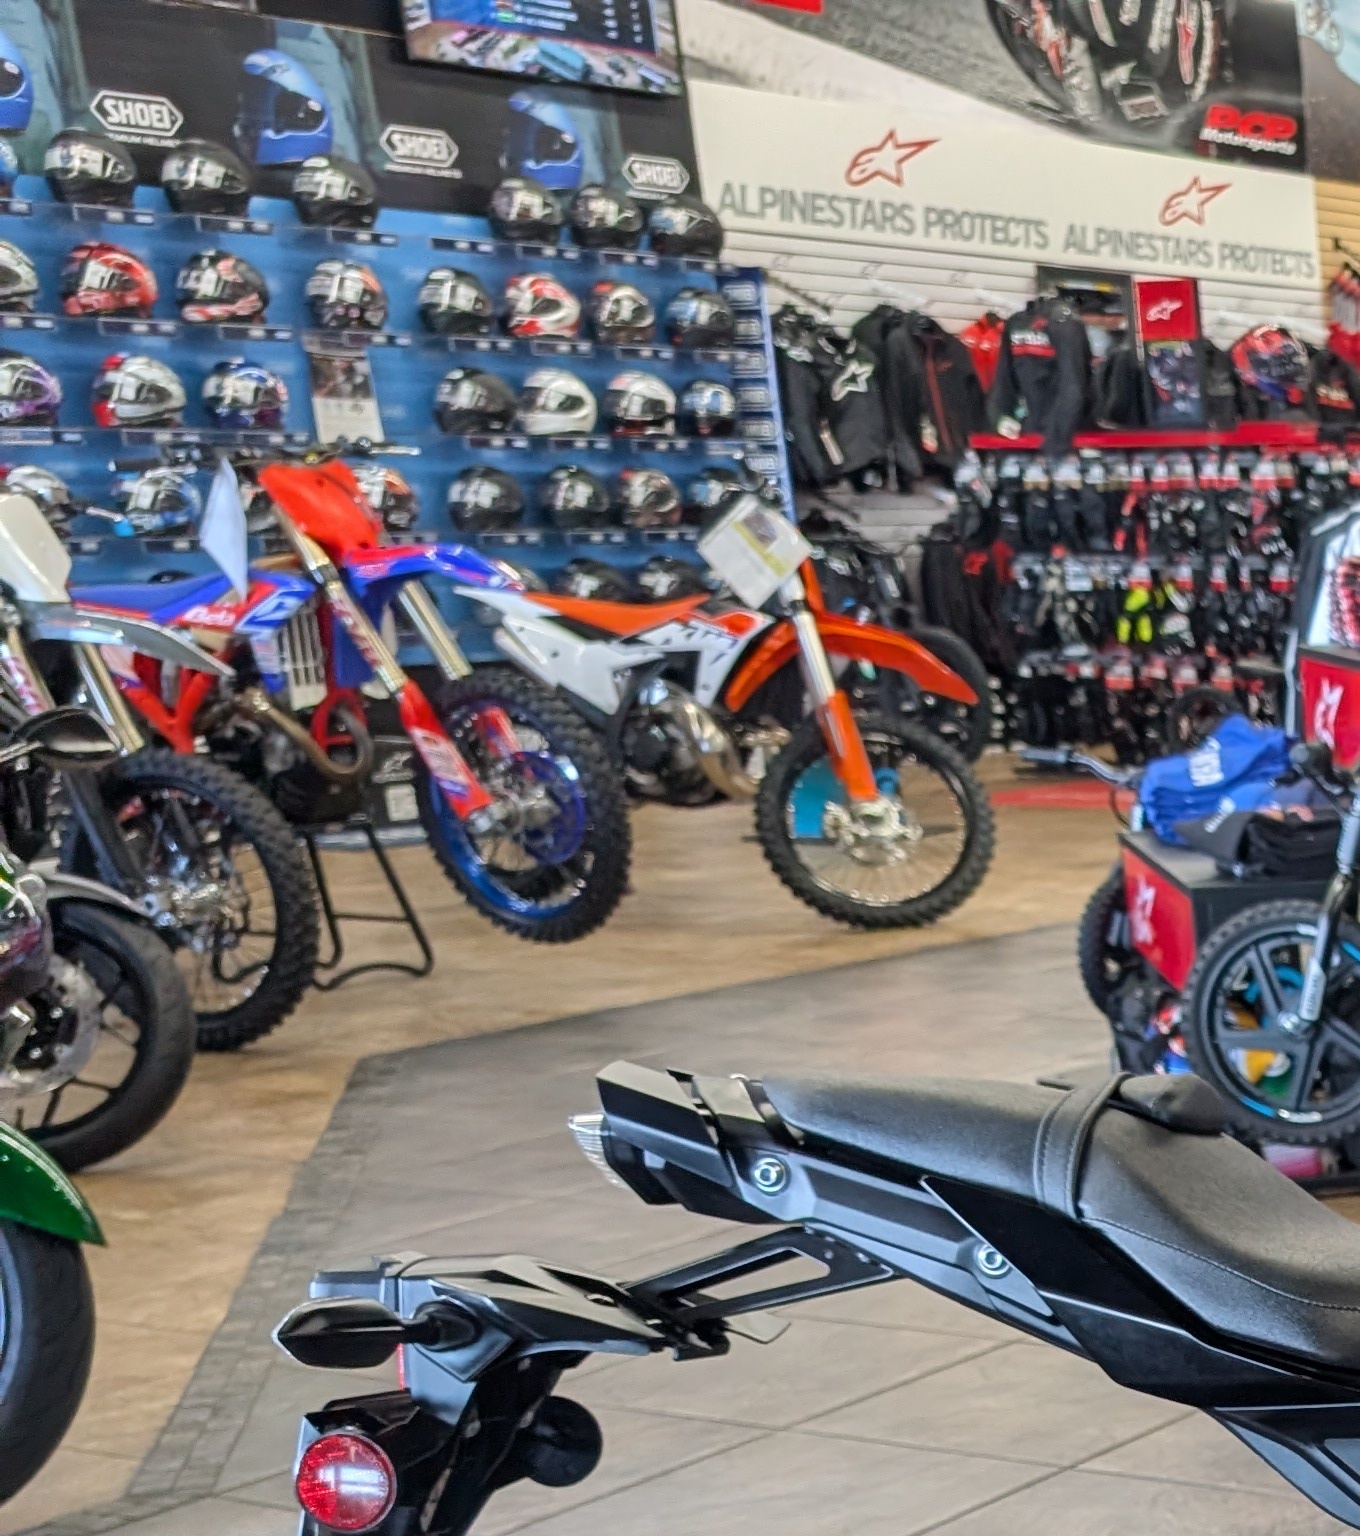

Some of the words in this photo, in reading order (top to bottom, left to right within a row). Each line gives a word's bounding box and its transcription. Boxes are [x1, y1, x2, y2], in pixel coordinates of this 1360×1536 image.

[102, 98, 172, 130] SHOEI
[1205, 103, 1297, 141] PCP
[717, 182, 917, 236] ALPINESTARS
[921, 205, 1050, 250] PROTECTS
[1063, 222, 1214, 269] ALPINESTARS
[1218, 242, 1317, 280] PROTECTS
